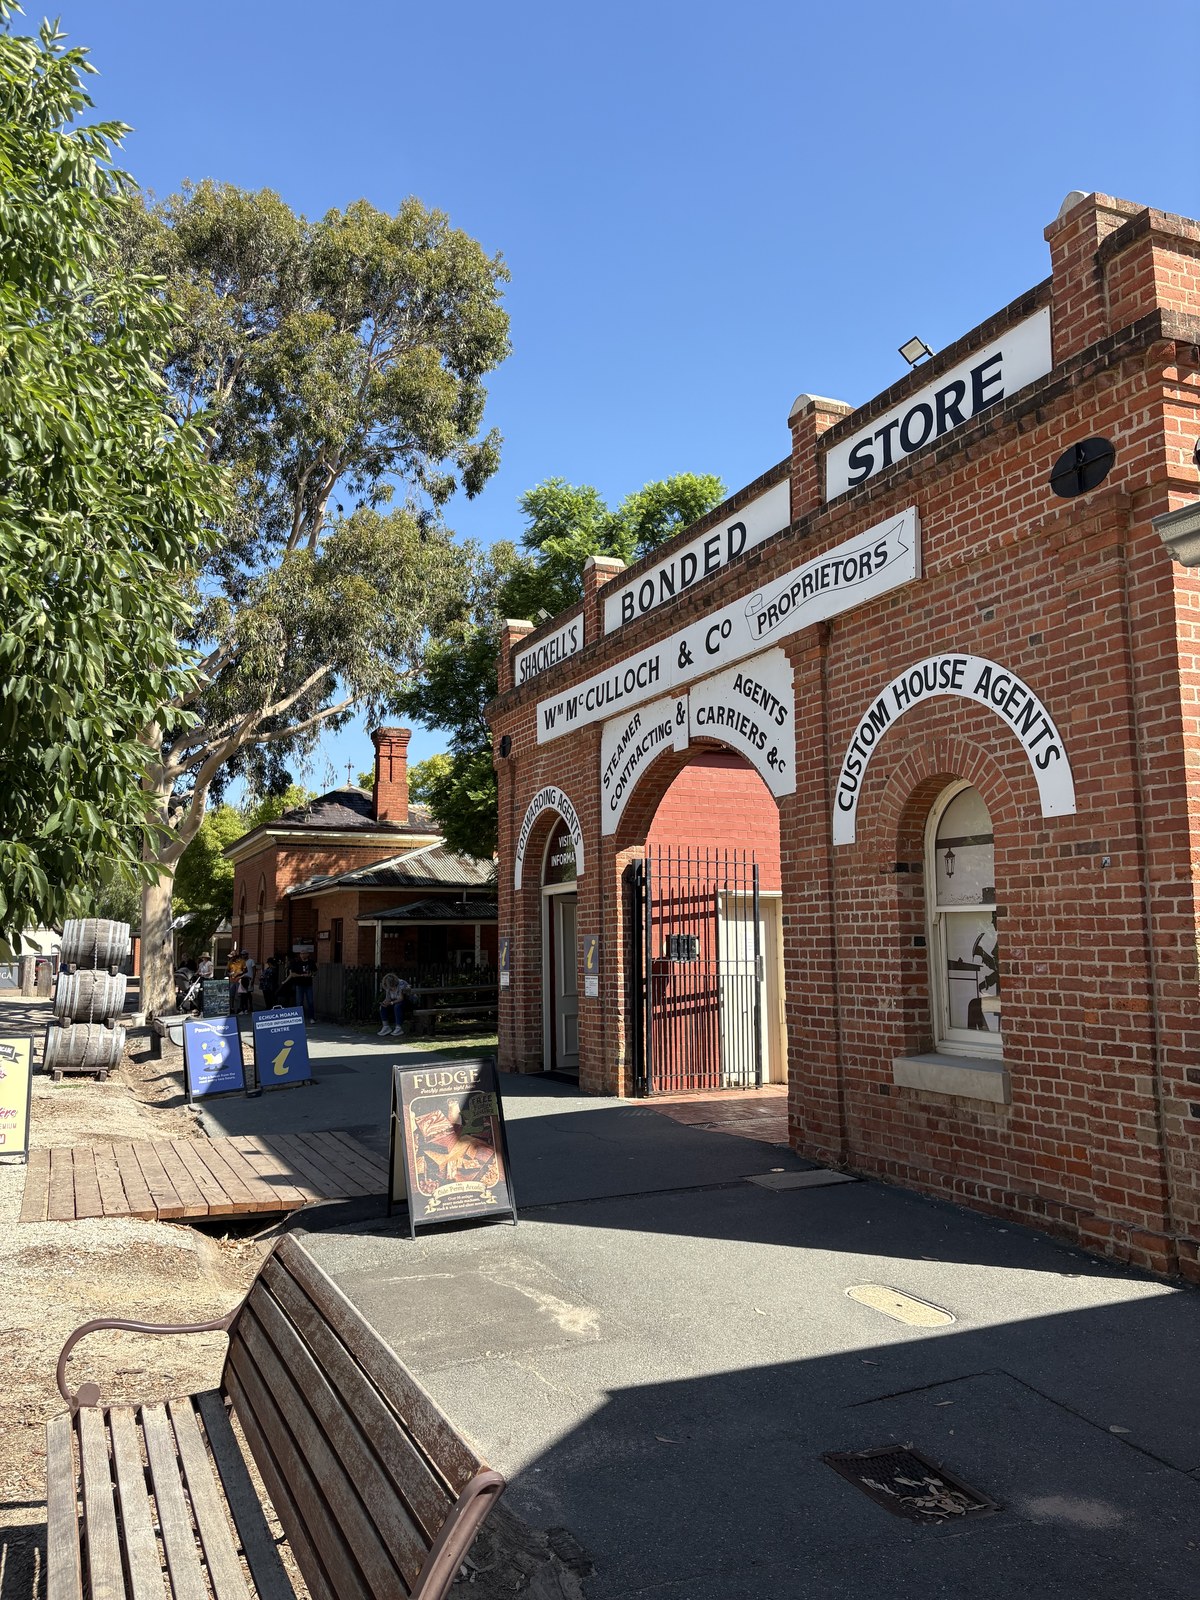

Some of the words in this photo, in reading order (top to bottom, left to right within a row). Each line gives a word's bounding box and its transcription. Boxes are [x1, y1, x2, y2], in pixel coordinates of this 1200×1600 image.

[847, 351, 1005, 487] STORE
[620, 521, 747, 625] BONDED
[757, 540, 888, 635] PROPRIETORS
[519, 624, 578, 683] SHACKELL'S
[677, 639, 694, 669] &
[696, 706, 769, 751] CARRIERS
[732, 673, 788, 727] AGENTS
[838, 697, 891, 812] CUSTOM
[891, 658, 967, 710] HOUSE
[973, 665, 1061, 770] AGENTS
[602, 712, 643, 790] STEAMER
[610, 719, 673, 811] CONTRACTING
[675, 700, 686, 727] &
[517, 788, 556, 862] FORWARDING
[556, 793, 582, 846] AGENTS
[0, 972, 12, 980] CA
[413, 1069, 481, 1089] FUDGE
